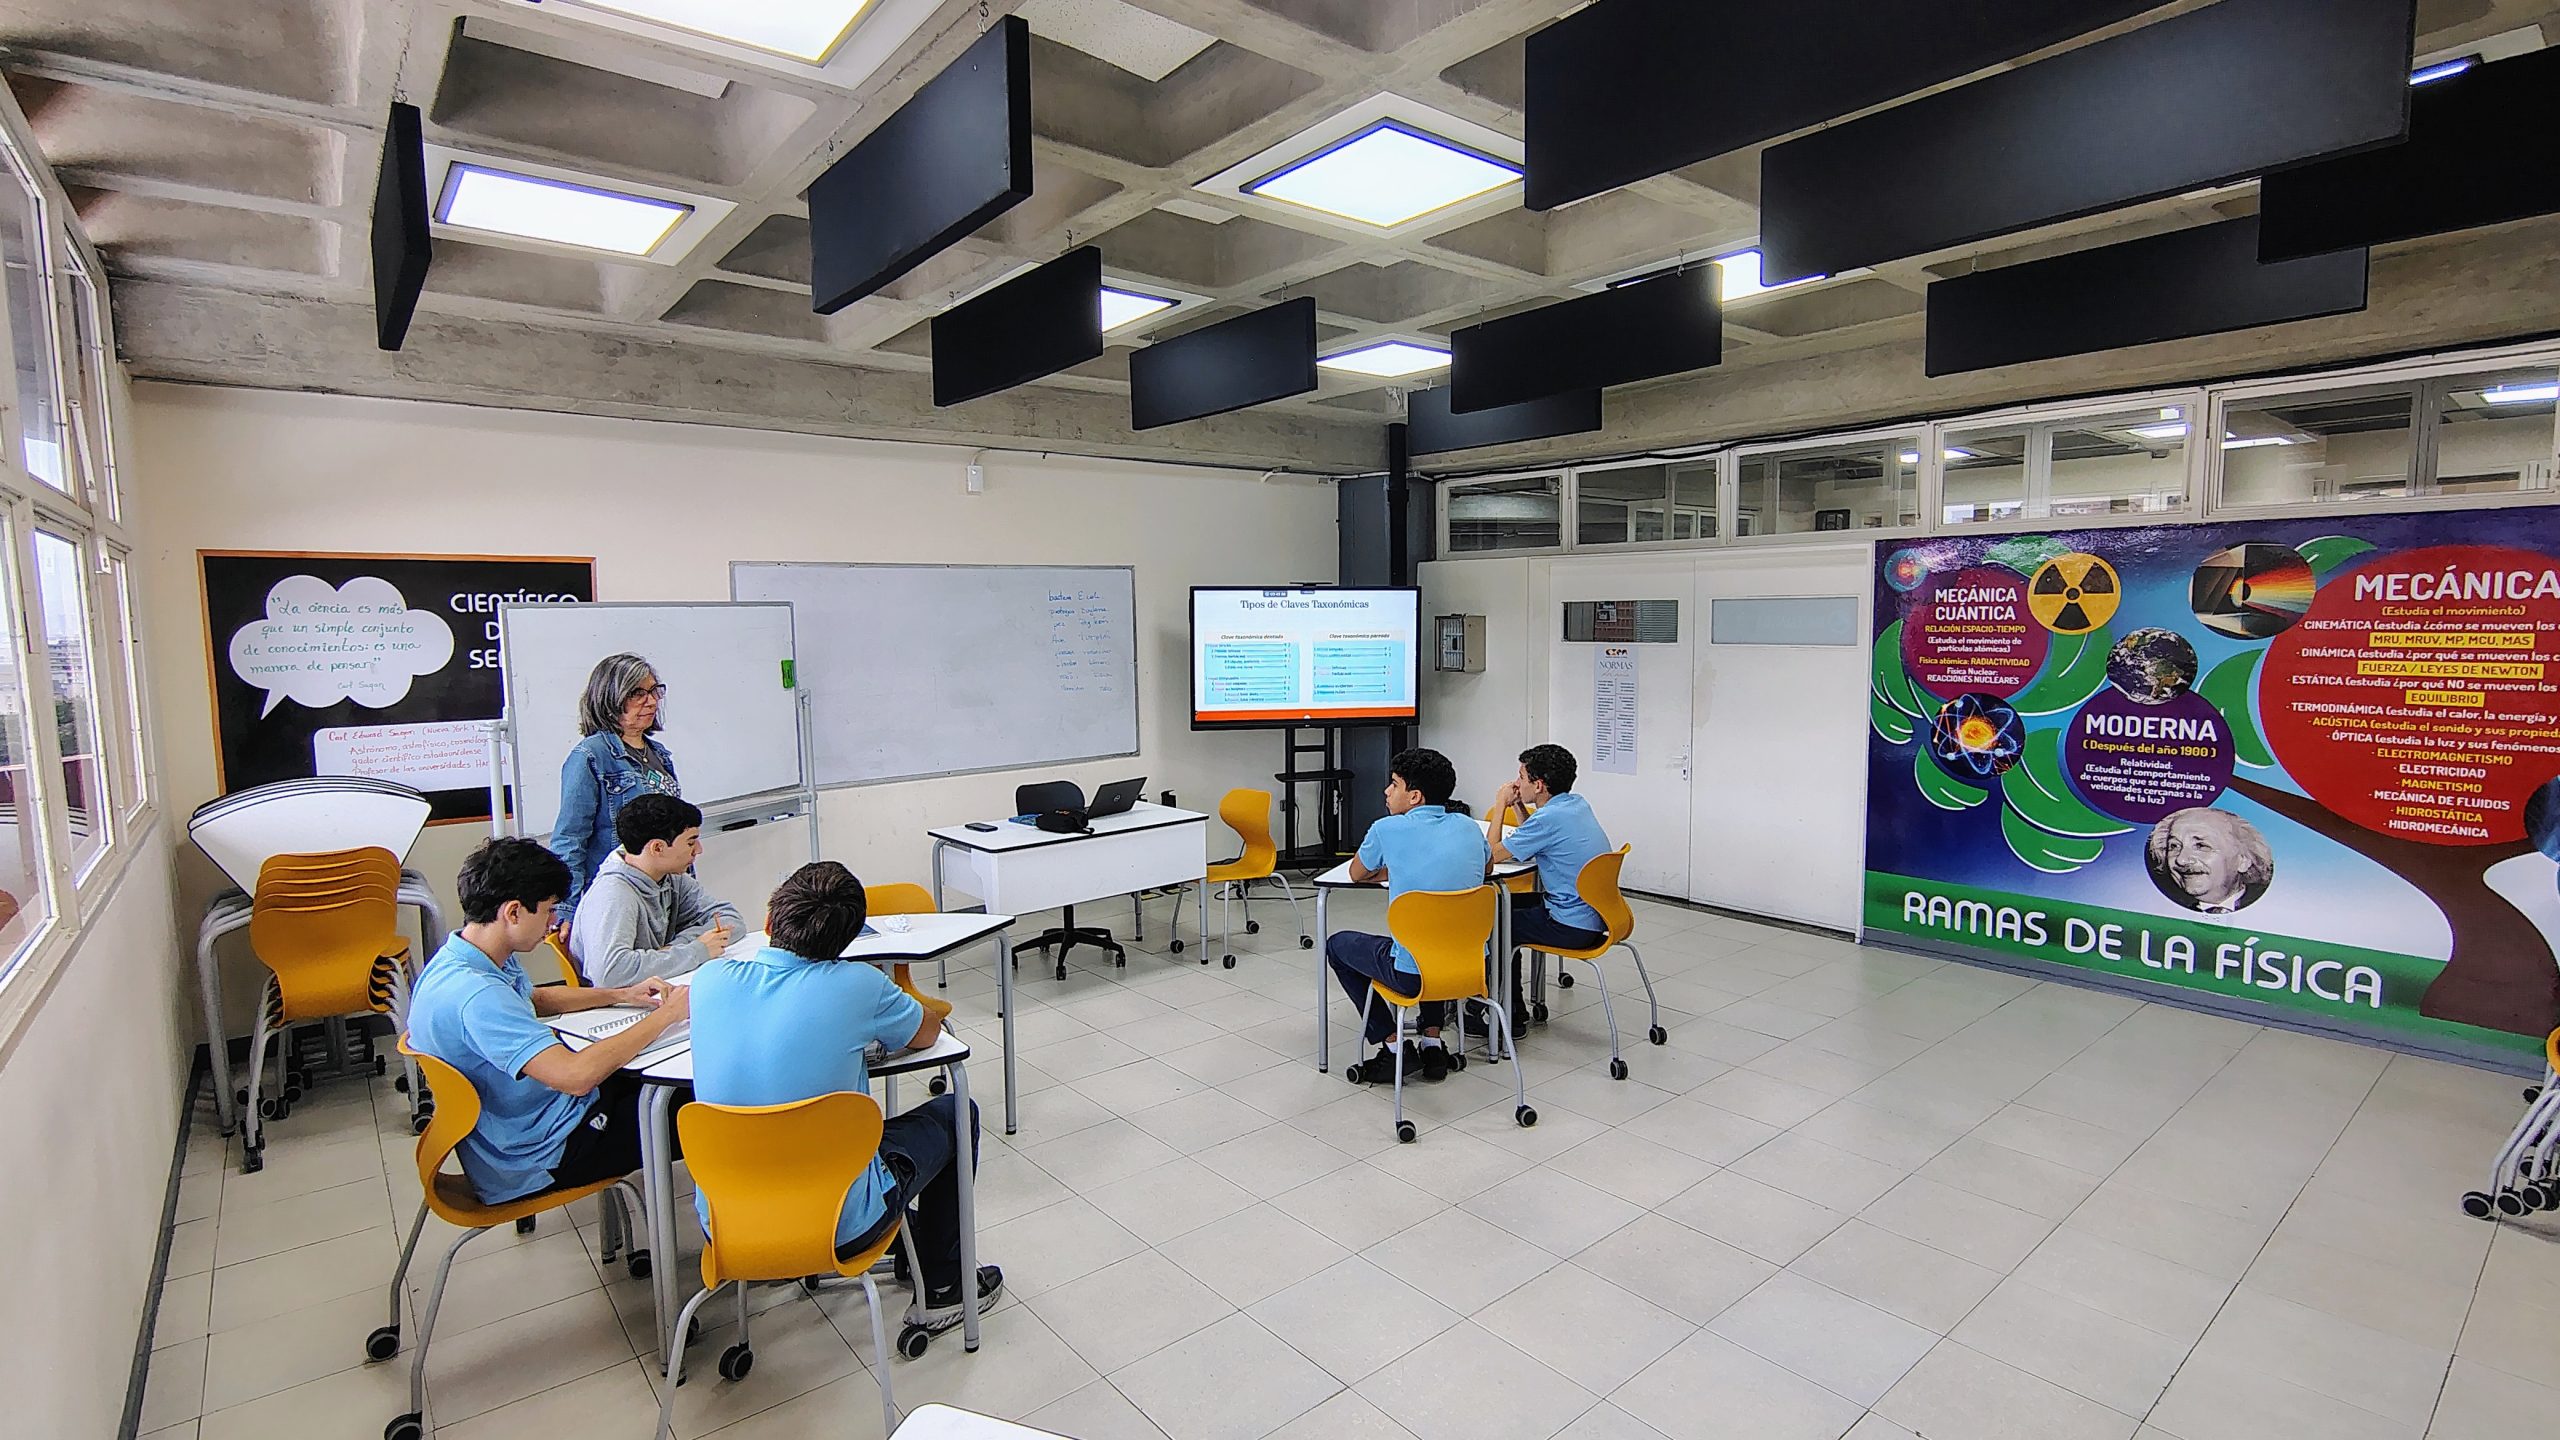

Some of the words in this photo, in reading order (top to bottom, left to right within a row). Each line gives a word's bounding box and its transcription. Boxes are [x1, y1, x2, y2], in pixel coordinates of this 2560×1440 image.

[2355, 565, 2560, 601] MECÁNICA
[1936, 584, 2018, 603] MECÁNICA
[308, 602, 350, 613] ciencia
[358, 604, 371, 614] es
[378, 603, 404, 614] más
[1240, 600, 1265, 610] Tipos
[1268, 600, 1278, 608] de
[1280, 600, 1310, 609] Claves
[1312, 600, 1370, 608] Taxonómicas
[1936, 602, 2016, 620] CUÁNTICA
[2382, 606, 2430, 616] (Estudia
[2432, 606, 2444, 616] el
[2446, 606, 2526, 616] movimiento)
[262, 625, 284, 639] que
[293, 624, 308, 633] un
[315, 621, 354, 636] simple
[362, 621, 414, 638] conjunto
[1925, 624, 1960, 632] RELACIÓN
[1962, 625, 2026, 633] ESPACIO-TIEMPO
[2304, 619, 2372, 630] CINEMÁTICA
[2374, 620, 2420, 630] (estudia
[2423, 620, 2462, 630] ¿cómo
[2536, 620, 2556, 630] los
[244, 644, 259, 656] de
[268, 638, 368, 652] conocimientos:
[374, 643, 386, 651] es
[392, 642, 421, 651] una
[1966, 637, 2010, 645] movimiento
[2374, 636, 2402, 645] MRU,
[2405, 636, 2442, 645] MRUV,
[2444, 636, 2466, 645] MP,
[2468, 636, 2498, 646] MCU,
[2502, 636, 2530, 646] MAS
[2302, 646, 2356, 658] DINÁMICA
[2358, 648, 2404, 658] (estudia
[2406, 650, 2432, 660] ¿por
[2436, 650, 2458, 660] qué
[2532, 651, 2550, 661] los
[250, 663, 300, 674] manera
[307, 660, 323, 671] de
[1600, 661, 1632, 670] NORMAS
[1971, 658, 2030, 666] RADIACTIVIDAD
[2362, 664, 2408, 672] FUERZA
[2420, 664, 2458, 674] LEYES
[2462, 665, 2478, 674] DE
[2482, 666, 2538, 676] NEWTON
[338, 682, 352, 690] Carl
[358, 681, 386, 690] Sagan
[1927, 674, 1972, 683] REACCIONES
[1974, 676, 2019, 684] NUCLEARES
[2292, 674, 2343, 685] ESTÁTICA
[2345, 676, 2390, 687] (estudia
[2393, 678, 2419, 689] ¿por
[2422, 680, 2444, 690] qué
[2448, 680, 2464, 689] NO
[2484, 683, 2535, 691] mueven
[2538, 682, 2558, 692] los
[2411, 692, 2478, 704] EQUILIBRIO
[2291, 702, 2384, 715] TERMODINÁMICA
[2386, 706, 2432, 717] (estudia
[2435, 708, 2446, 718] el
[2448, 710, 2482, 720] calor,
[2484, 710, 2496, 720] la
[2498, 712, 2546, 724] energía
[2548, 715, 2558, 724] y
[329, 731, 347, 741] Carl
[453, 724, 469, 732] York
[2086, 714, 2218, 742] MODERNA
[2313, 716, 2368, 728] ACÚSTICA
[2370, 720, 2416, 731] (estudia
[2419, 722, 2430, 732] el
[2432, 723, 2472, 734] sonido
[2474, 727, 2483, 736] y
[2484, 727, 2506, 736] sus
[2332, 730, 2372, 742] ÓPTICA
[2375, 734, 2421, 746] (estudia
[2424, 736, 2435, 746] la
[2438, 738, 2455, 746] luz
[2457, 741, 2466, 750] y
[2468, 741, 2488, 750] sus
[2137, 744, 2154, 754] del
[2157, 746, 2178, 756] año
[2378, 748, 2512, 766] ELECTROMAGNETISMO
[352, 767, 386, 776] Profesor
[390, 766, 400, 774] de
[419, 760, 471, 771] universidades
[2120, 758, 2174, 770] Relatividad:
[2399, 764, 2486, 778] ELECTRICIDAD
[2086, 764, 2122, 774] (Estudia
[2123, 766, 2132, 776] el
[2134, 768, 2210, 782] comportamiento
[2080, 772, 2091, 781] de
[2092, 775, 2128, 786] cuerpos
[2130, 778, 2146, 787] que
[2160, 780, 2207, 792] desplazan
[2402, 778, 2482, 793] MAGNETISMO
[2090, 783, 2142, 794] velocidades
[2144, 788, 2184, 798] cercanas
[2194, 790, 2202, 800] la
[2124, 793, 2136, 802] de
[2138, 794, 2146, 802] la
[2147, 795, 2166, 804] luz)
[2374, 790, 2435, 804] MECÁNICA
[2438, 795, 2454, 806] DE
[2456, 797, 2510, 810] FLUIDOS
[2396, 806, 2483, 822] HIDROSTÁTICA
[2388, 820, 2488, 838] HIDROMECÁNICA
[1904, 891, 2048, 946] RAMAS
[2064, 918, 2124, 960] DE
[2140, 930, 2196, 974] LA
[2215, 937, 2382, 1008] FÍSICA
